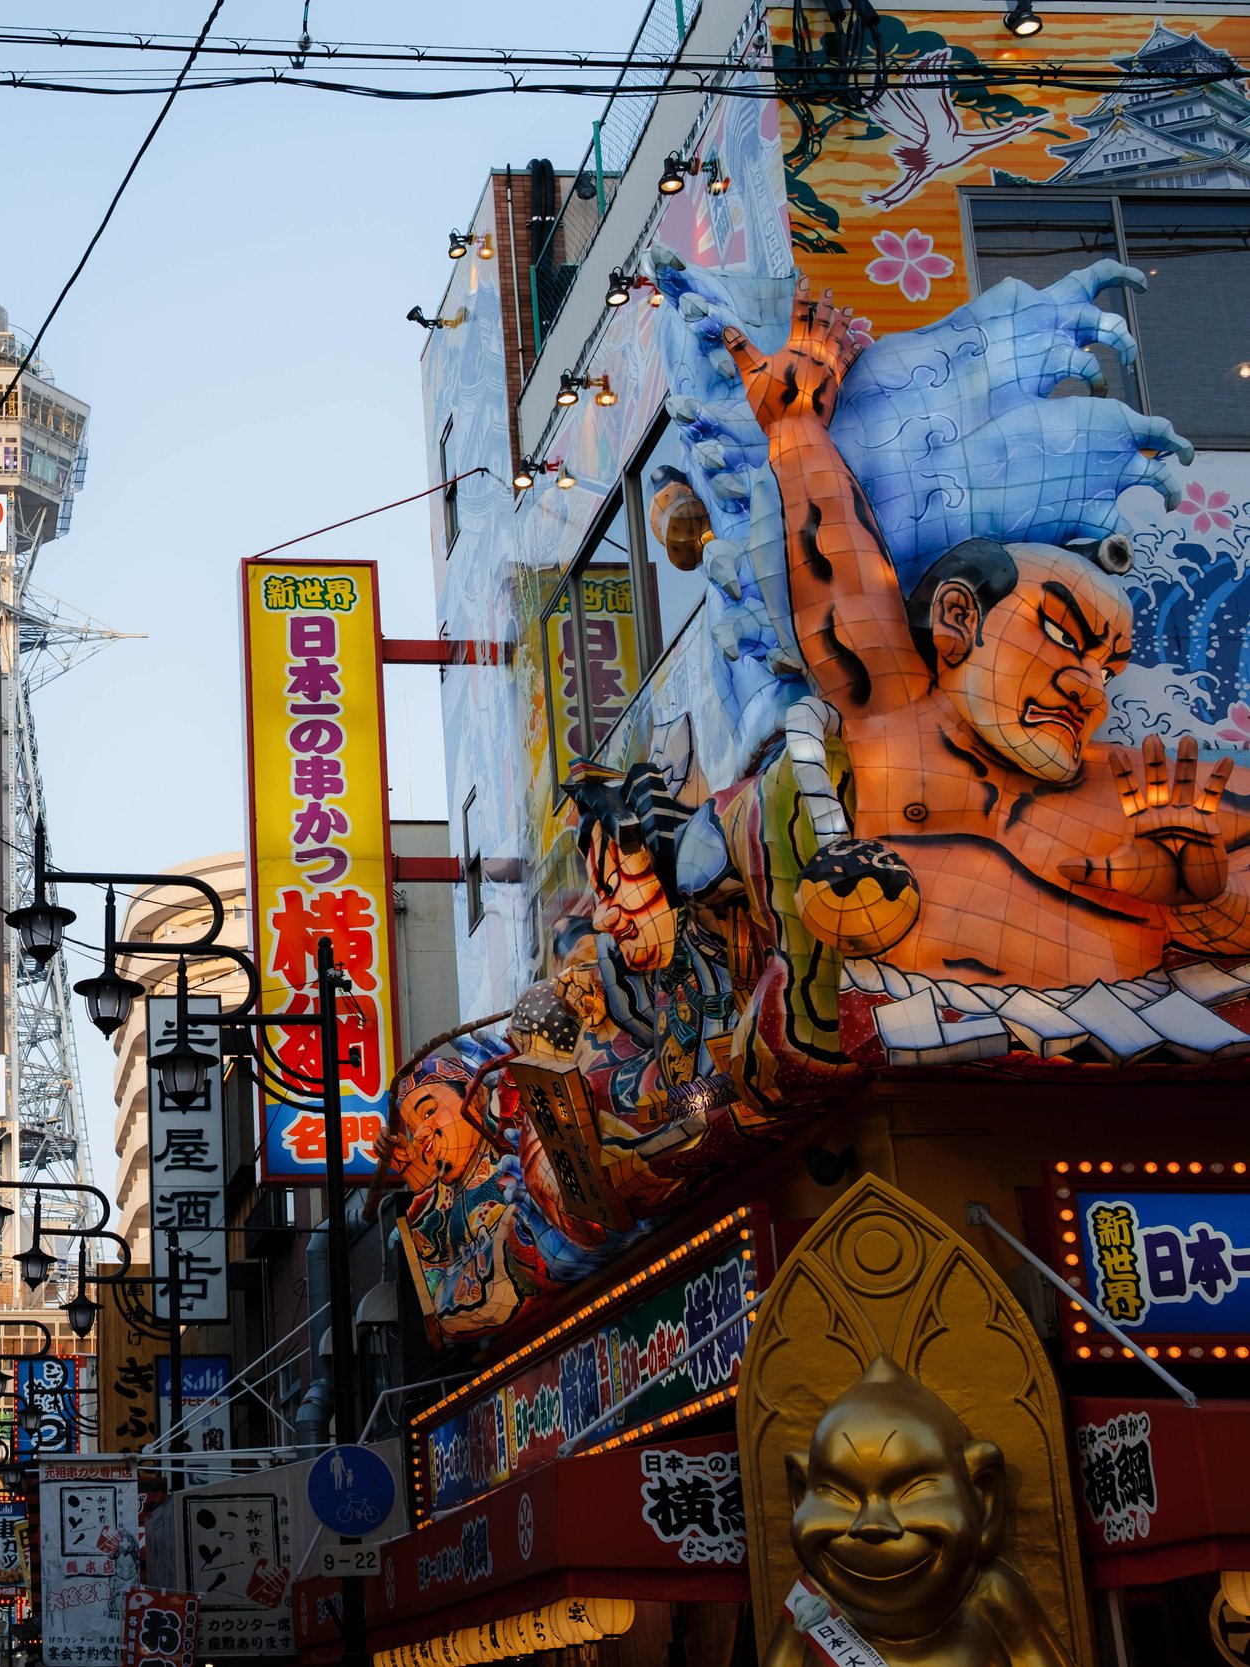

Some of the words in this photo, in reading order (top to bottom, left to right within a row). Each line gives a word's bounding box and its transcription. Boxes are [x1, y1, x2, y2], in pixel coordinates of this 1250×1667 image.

[264, 576, 357, 611] 新世界
[286, 615, 349, 884] 日本一の串かつ
[272, 890, 381, 1097] 横綱
[1092, 1206, 1145, 1321] 新世界
[685, 1259, 746, 1392] 横綱
[559, 1338, 600, 1442] 横綱
[1078, 1414, 1150, 1450] 日本一の串かつ
[44, 1466, 132, 1479] 元祖串カツ専門店
[1083, 1440, 1154, 1518] 横綱
[324, 1551, 377, 1571] 9-22
